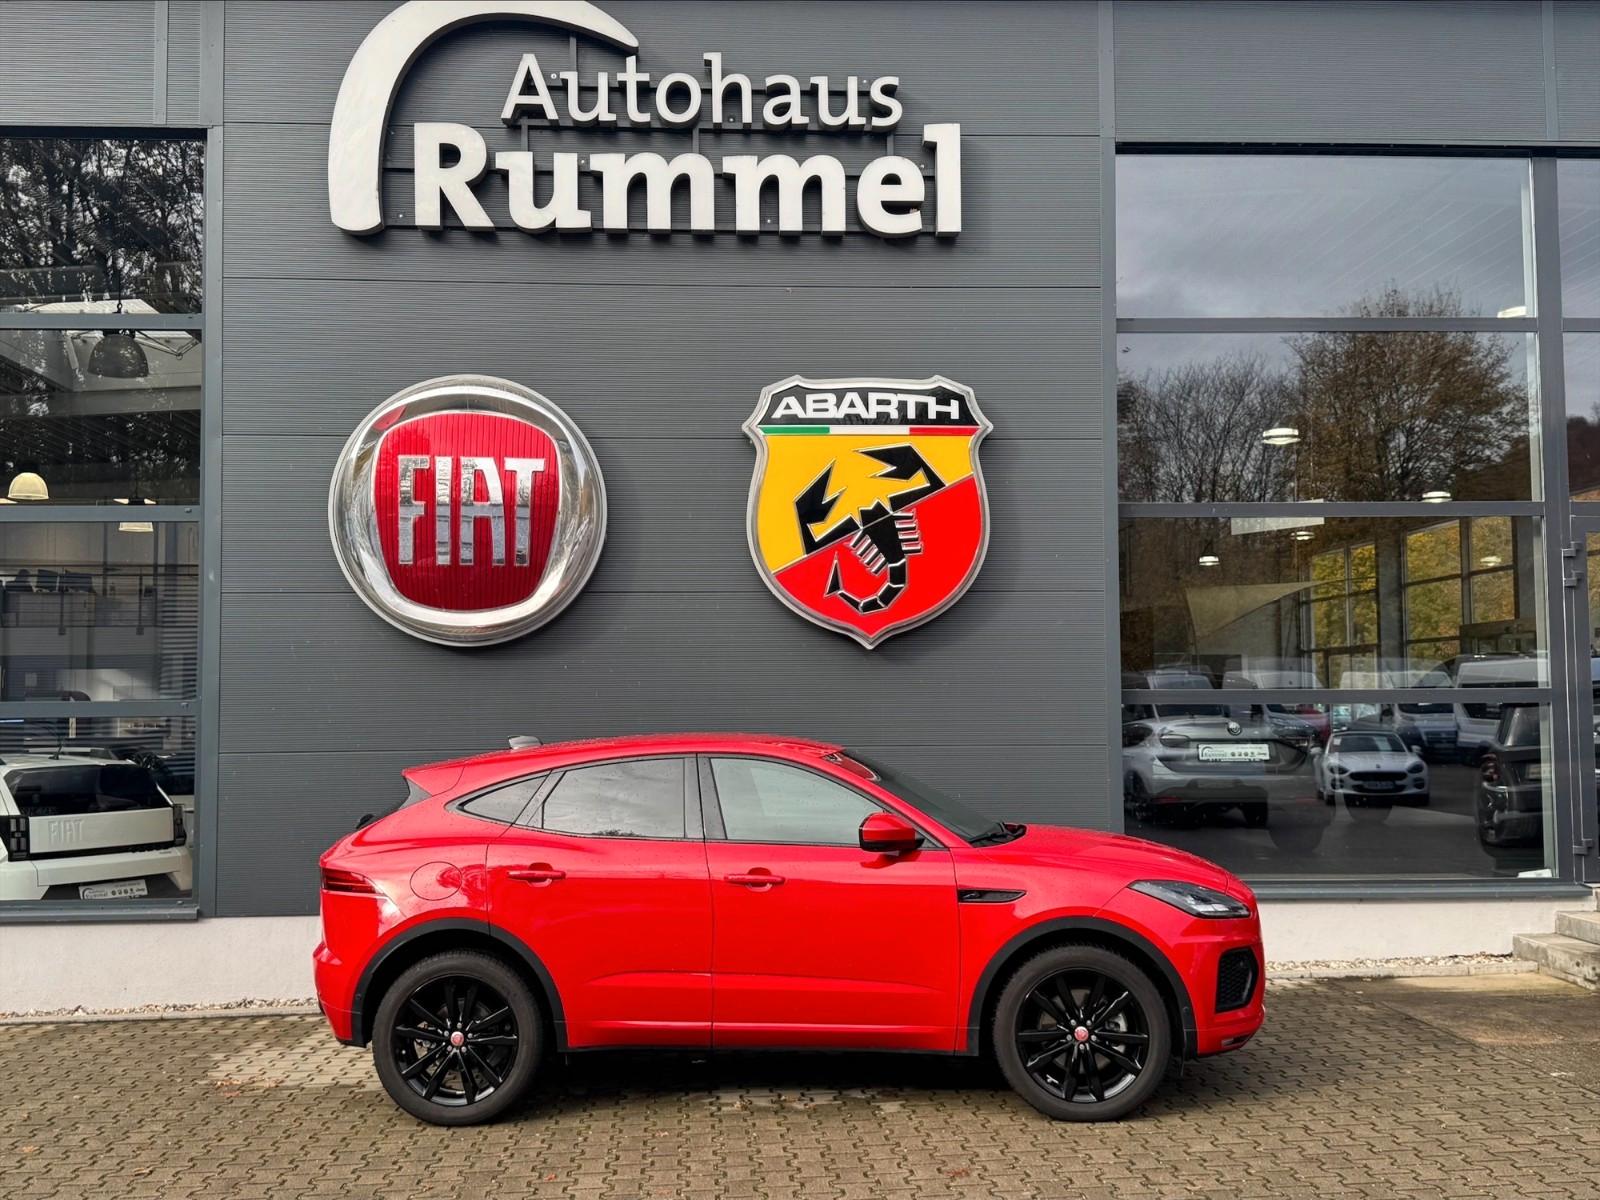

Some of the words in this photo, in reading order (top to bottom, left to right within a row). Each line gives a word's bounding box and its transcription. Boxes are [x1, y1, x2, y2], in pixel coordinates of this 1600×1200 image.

[501, 51, 903, 126] Autohaus
[413, 121, 962, 235] Rummel
[770, 391, 960, 420] ABARTH
[397, 456, 546, 568] FIAT
[48, 819, 85, 845] FIAT
